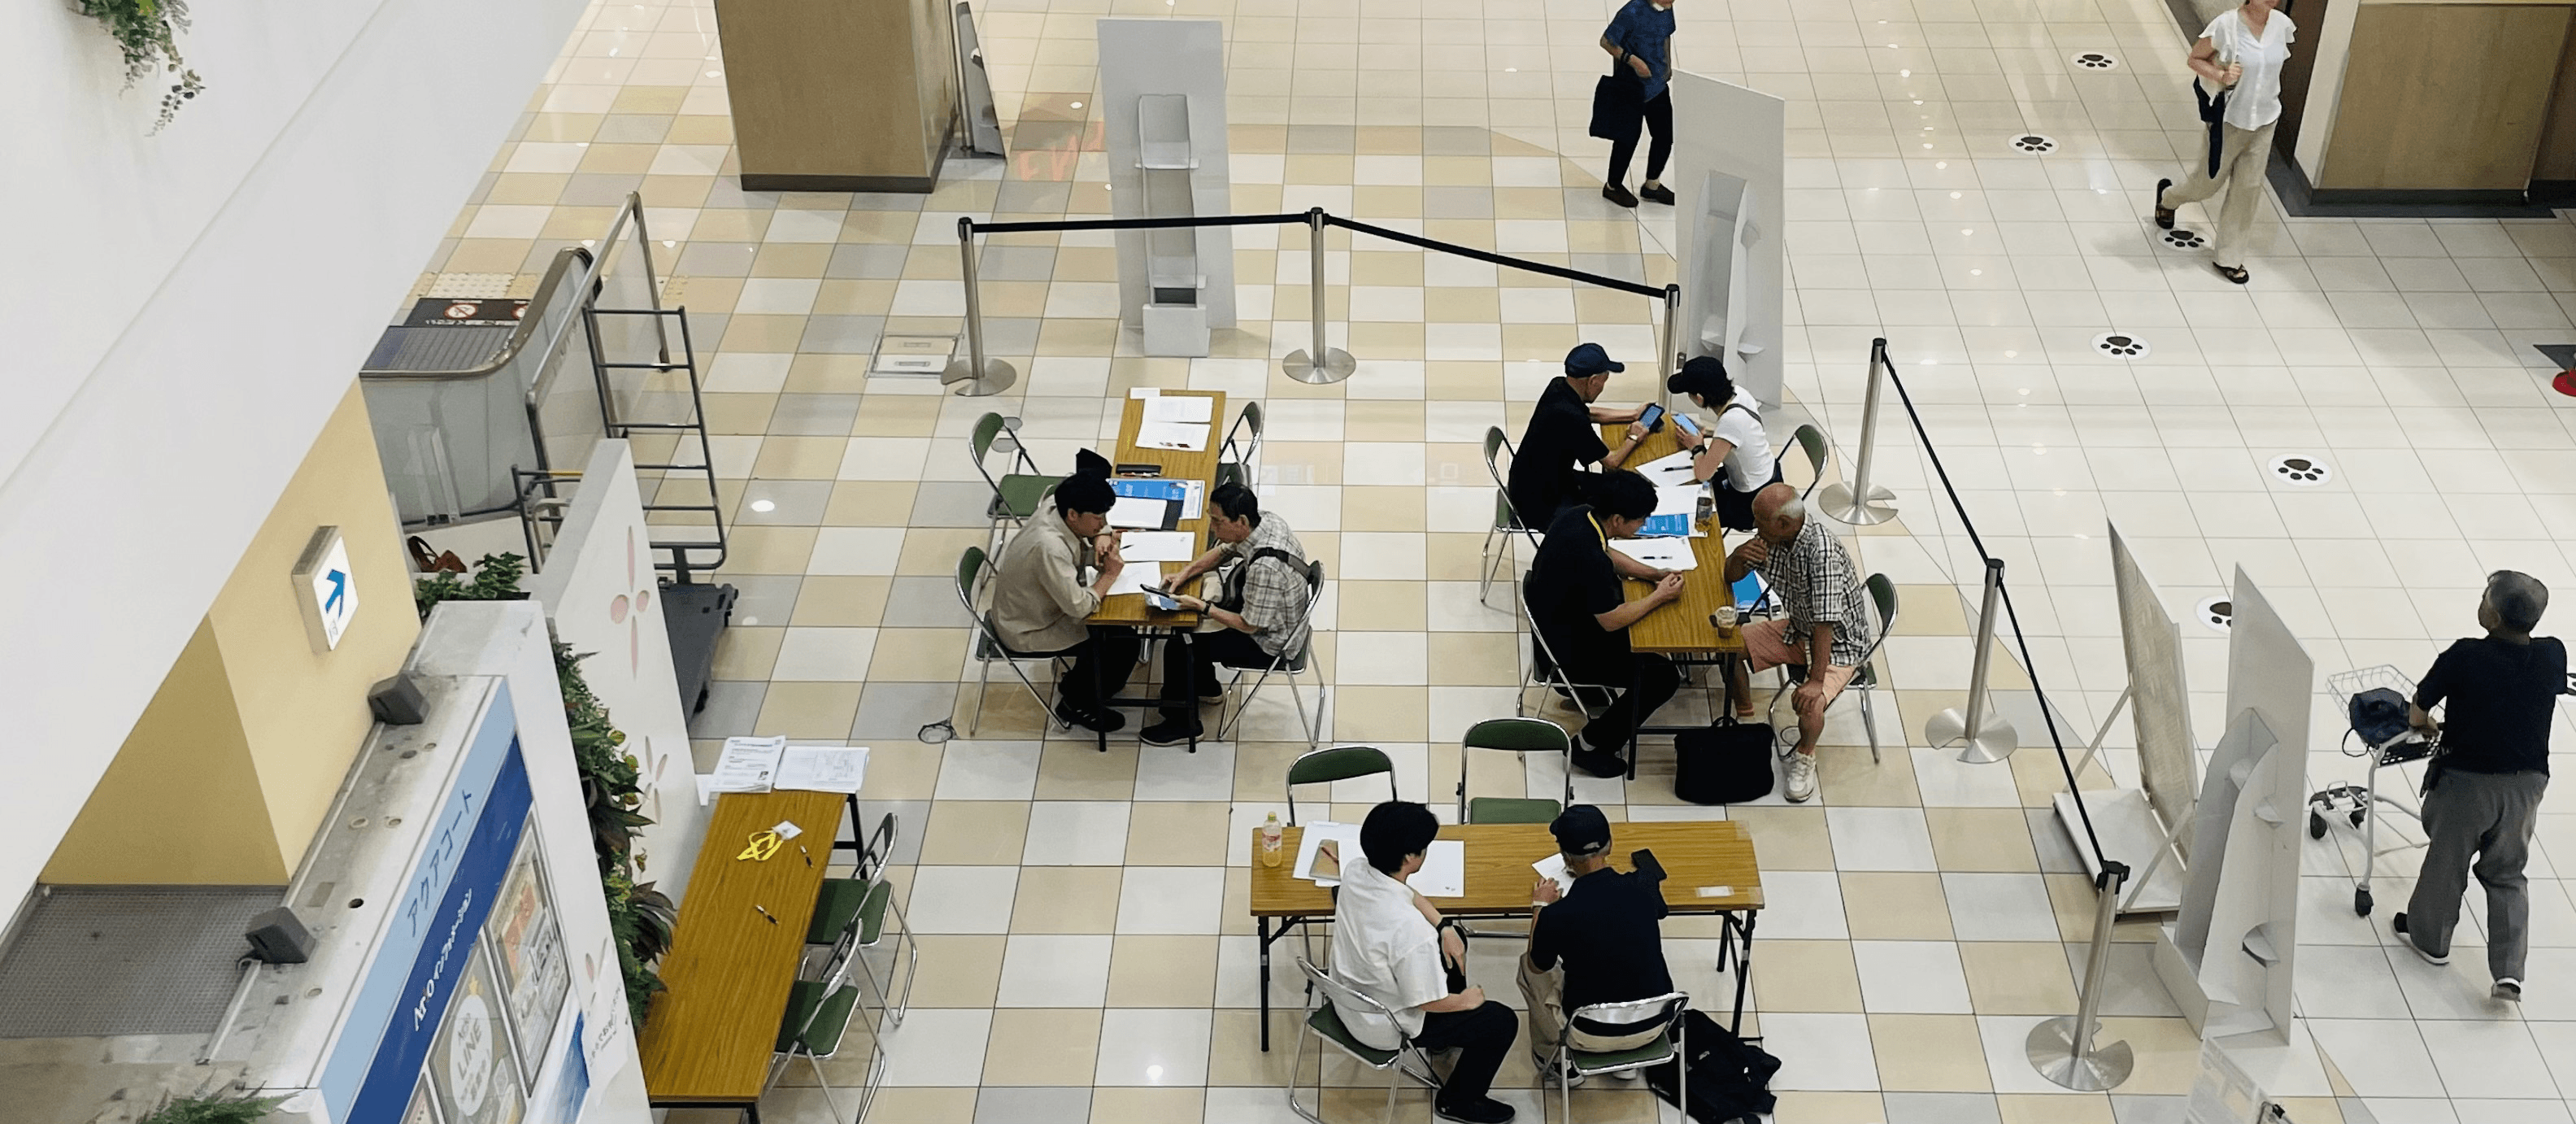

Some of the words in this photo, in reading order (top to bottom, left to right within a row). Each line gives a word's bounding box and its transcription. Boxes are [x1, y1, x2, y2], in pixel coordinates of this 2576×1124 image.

[407, 789, 472, 938] アクアコート
[458, 1017, 481, 1081] LINE
